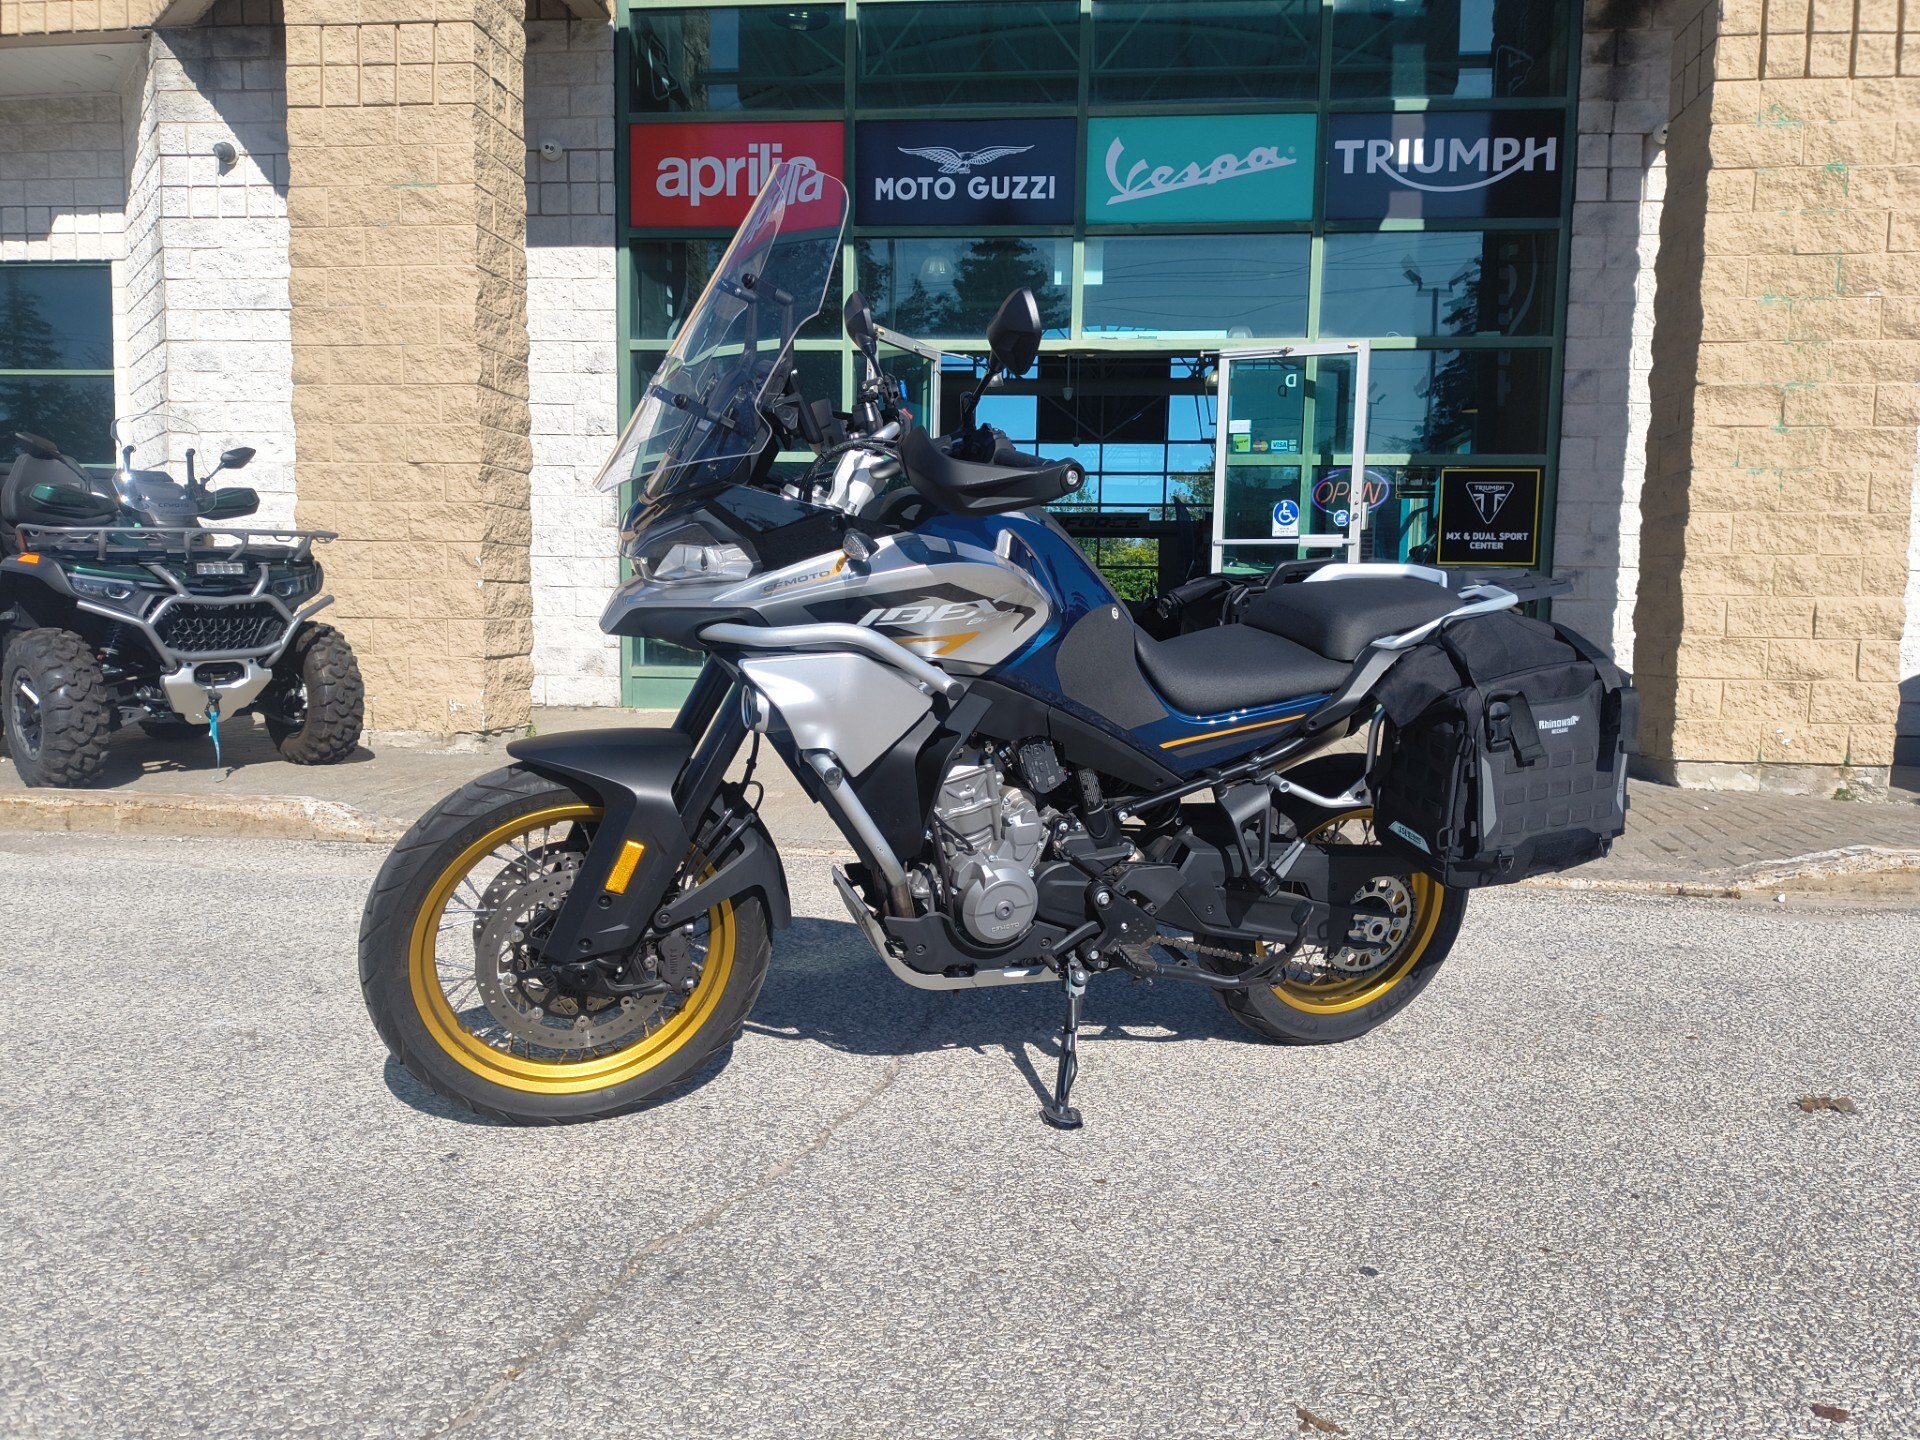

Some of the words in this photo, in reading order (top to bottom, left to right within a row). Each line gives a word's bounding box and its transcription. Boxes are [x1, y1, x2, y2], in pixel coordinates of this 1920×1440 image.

[656, 143, 824, 206] aprilia
[1106, 137, 1297, 205] Vespa
[1334, 137, 1557, 192] TRIUMPH
[875, 177, 956, 200] MOTO
[967, 176, 1056, 200] GUZZI
[1316, 481, 1382, 504] OPN
[1475, 485, 1505, 493] TRIUMPH
[1446, 532, 1461, 540] MX
[1463, 532, 1471, 540] &
[1472, 532, 1497, 541] DUAL
[1499, 532, 1529, 541] SPORT
[1469, 541, 1504, 550] CENTER
[763, 570, 831, 592] CFMOTO
[855, 592, 1015, 628] IBEX
